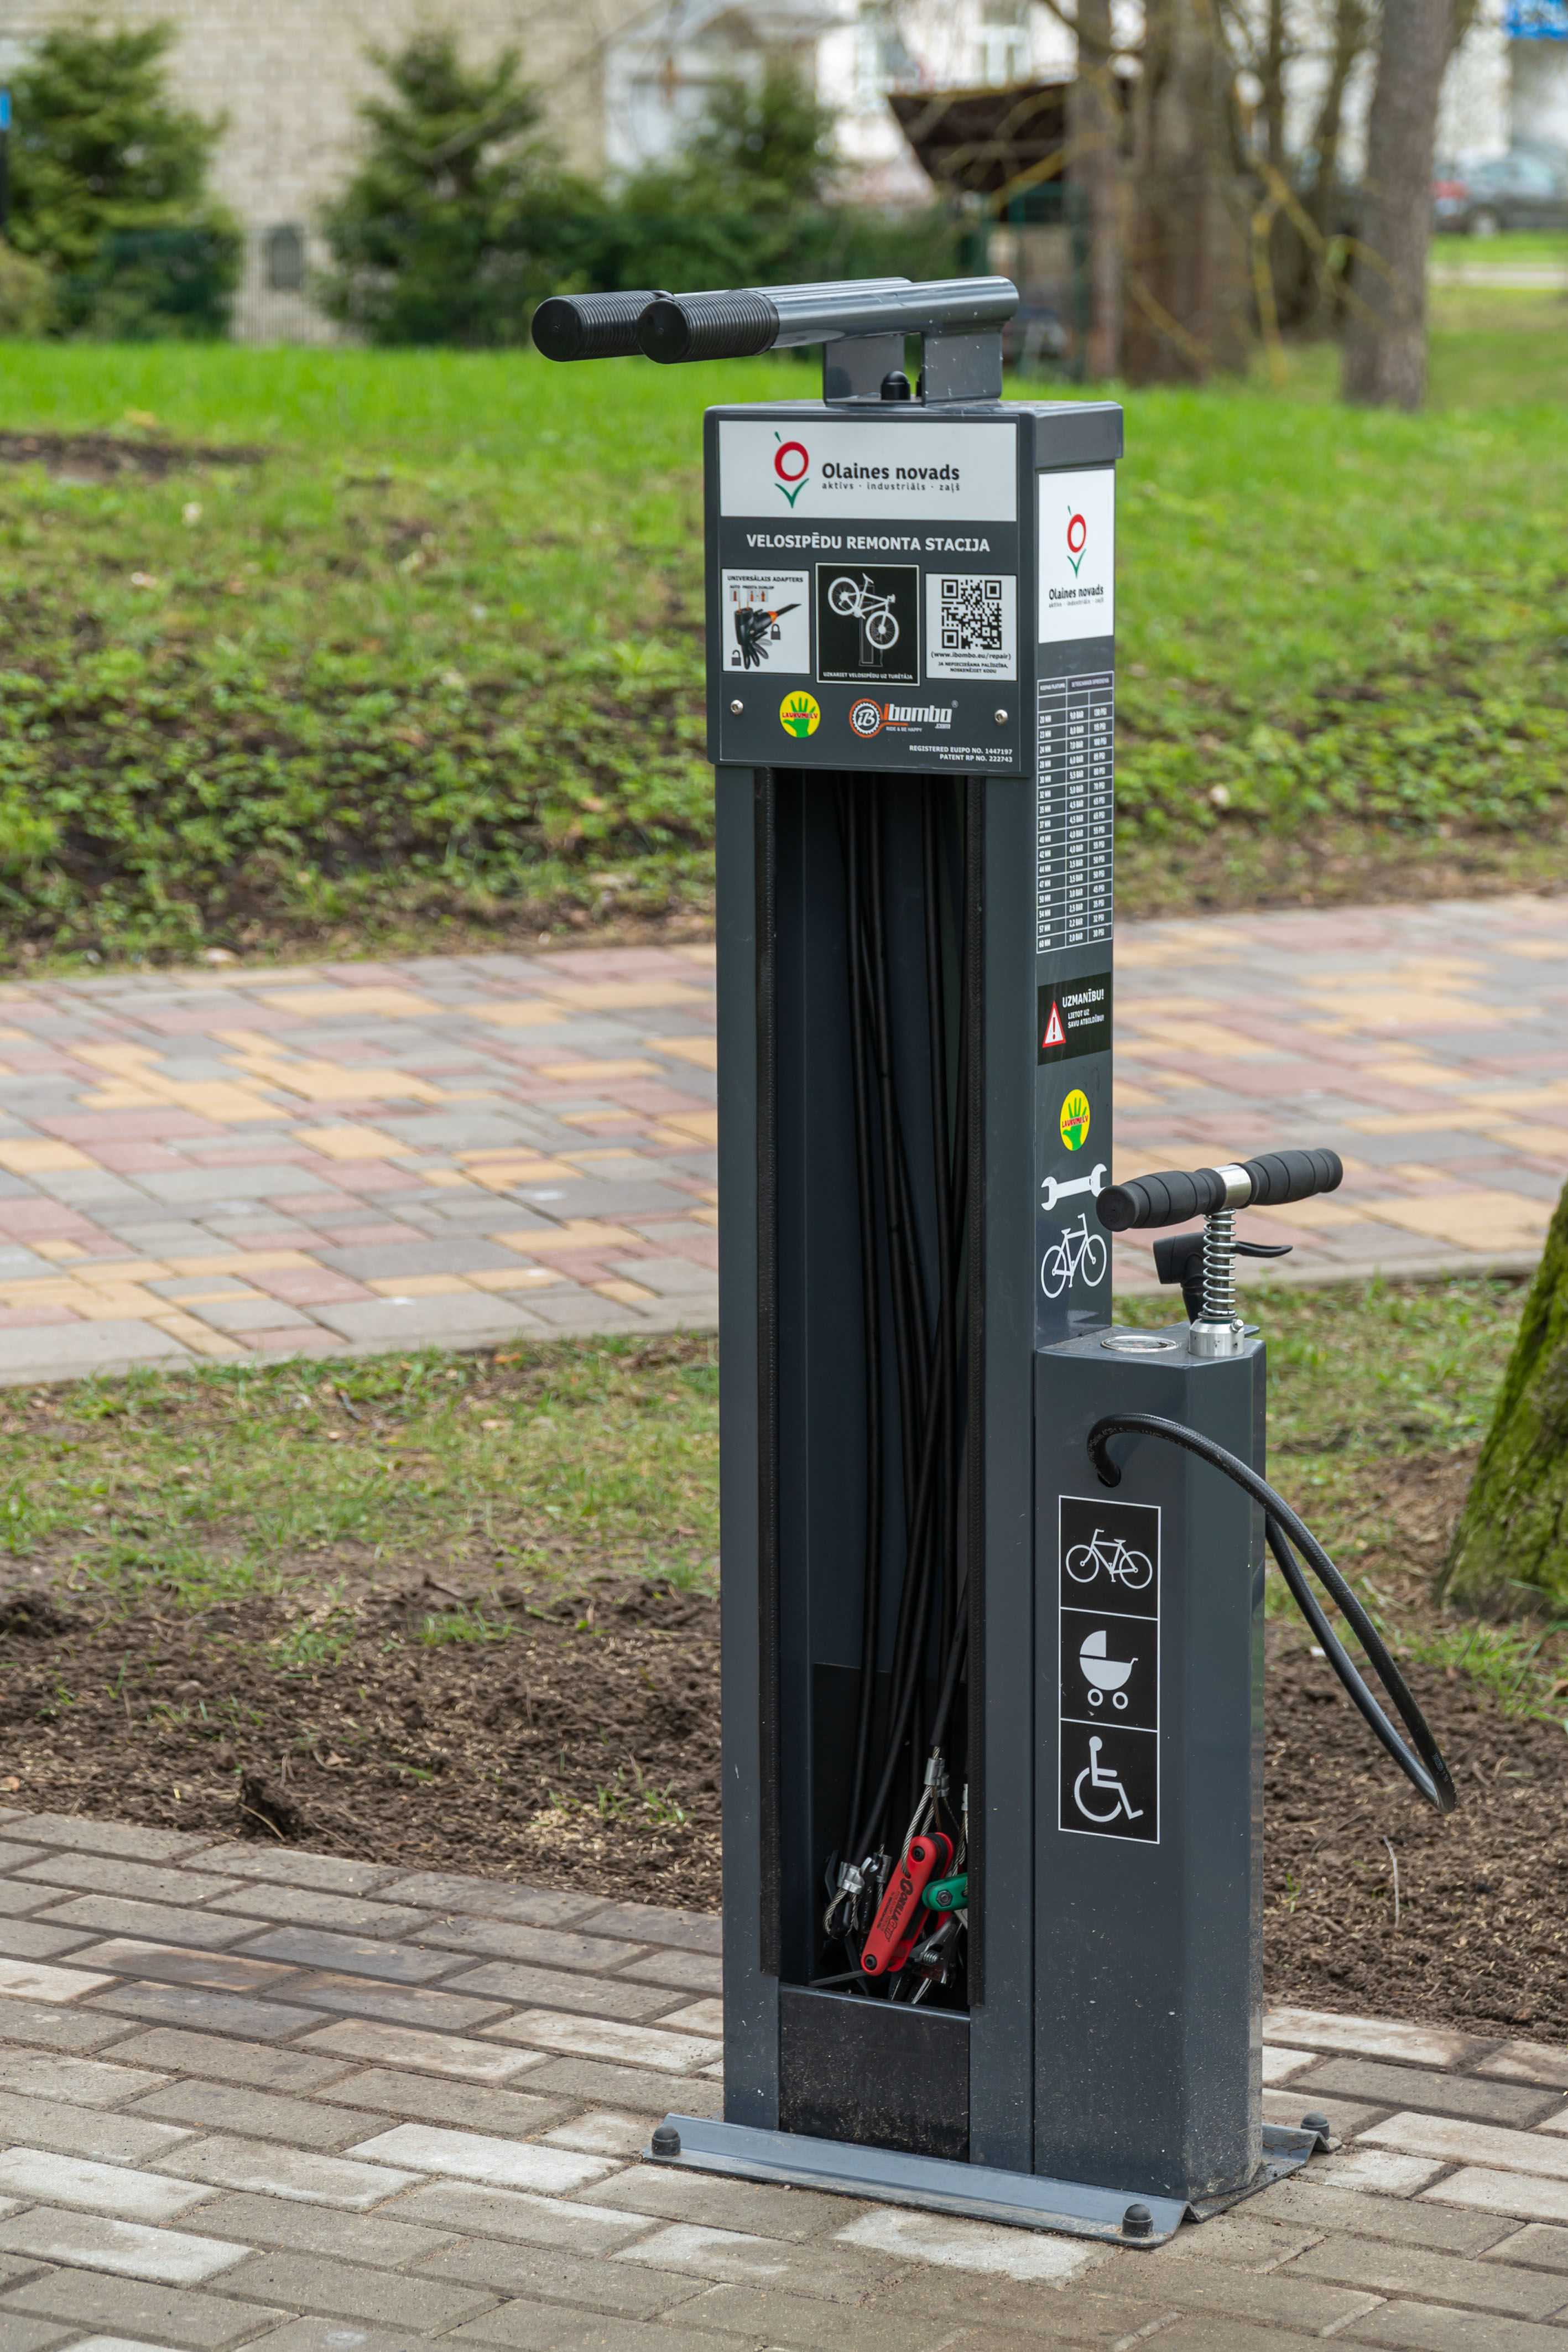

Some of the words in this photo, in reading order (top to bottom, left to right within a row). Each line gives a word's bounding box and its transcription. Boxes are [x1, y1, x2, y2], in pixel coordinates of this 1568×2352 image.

[822, 462, 890, 479] Olaines
[895, 464, 960, 480] novads
[822, 481, 853, 490] aktīvs
[867, 482, 926, 491] industriāls
[939, 482, 960, 493] zaļš
[746, 532, 841, 549] VELOSIPĒDU
[846, 535, 921, 551] REMONTA
[925, 537, 991, 552] STACIJA
[1049, 587, 1076, 600] Olaines
[1078, 583, 1103, 597] novads
[931, 651, 1011, 660] (www.ibombo.eu/repair)
[883, 703, 952, 723] ibombo
[1076, 710, 1084, 719] BAR
[1045, 715, 1051, 723] MM
[1045, 730, 1051, 738] MM
[909, 745, 949, 753] REGISTERED
[1045, 745, 1051, 753] MM
[1045, 759, 1051, 768] MM
[1045, 774, 1051, 783] MM
[1040, 790, 1044, 799] 32
[1045, 789, 1051, 798] MM
[1045, 804, 1051, 813] MM
[1040, 820, 1044, 829] 37
[1045, 819, 1051, 828] MM
[1045, 834, 1051, 842] MM
[1045, 849, 1051, 857] MM
[1045, 864, 1051, 872] MM
[1045, 879, 1051, 887] MM
[1045, 894, 1051, 902] MM
[1045, 909, 1051, 917] MM
[1045, 924, 1050, 932] MM
[1044, 939, 1050, 947] MM
[1062, 988, 1105, 1008] UZMANĪBU!
[1067, 1010, 1083, 1019] LIETOT
[1067, 1019, 1080, 1028] SAVU
[1061, 1115, 1088, 1128] LAUKUMI.LV
